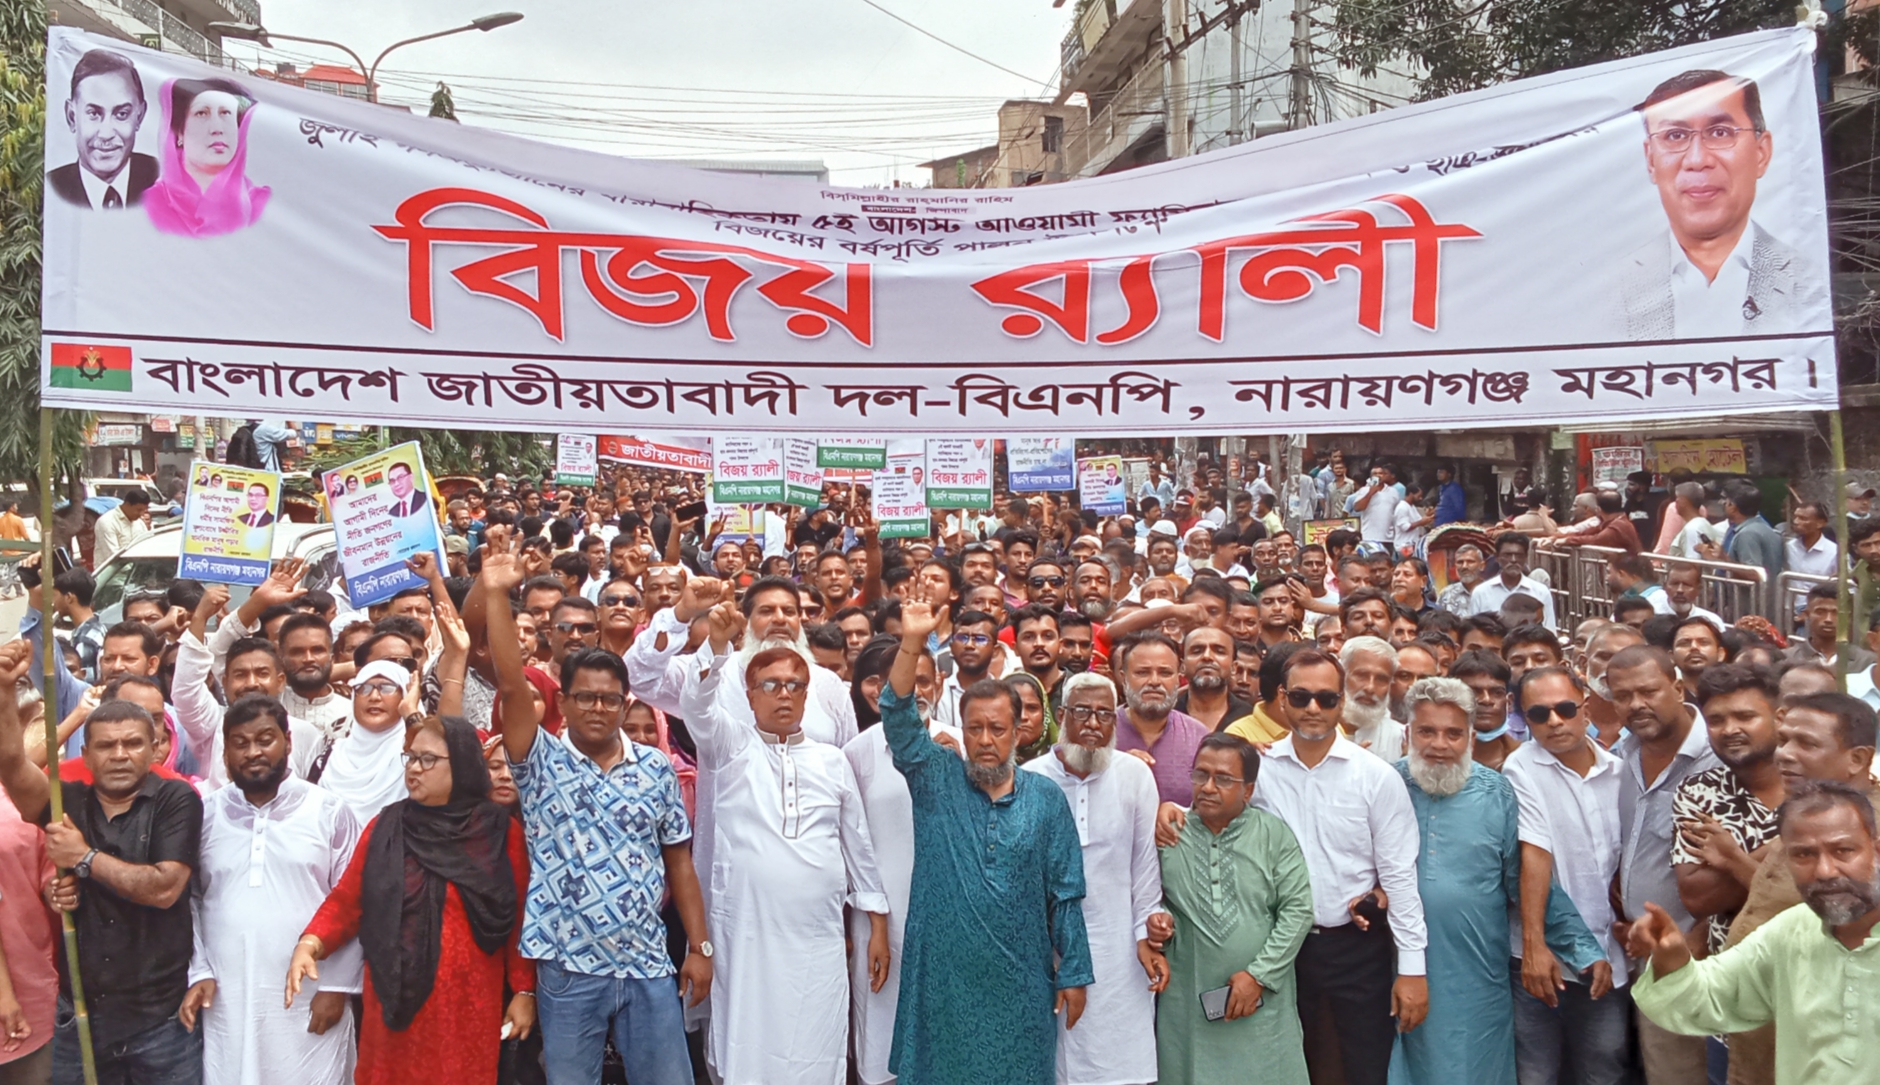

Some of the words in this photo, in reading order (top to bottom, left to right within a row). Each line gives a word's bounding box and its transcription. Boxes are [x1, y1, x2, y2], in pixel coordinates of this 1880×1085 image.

[812, 213, 859, 234] ৫ই
[867, 216, 965, 235] আগস্ট
[975, 210, 1101, 234] আওয়ামী
[714, 219, 827, 250] বিজয়ের
[836, 238, 945, 263] বর্ষপূর্তি
[369, 187, 874, 346] বিজয়
[970, 192, 1484, 345] র‍্যালী
[140, 357, 408, 402] বাংলাদেশ
[419, 363, 809, 417] জাতীয়তাবাদী
[1227, 367, 1530, 412] নারায়ণগঞ্জ
[620, 443, 712, 468] জাতীয়তাবাদী
[718, 460, 749, 477] বিজয়
[931, 468, 958, 485] বিজয়
[348, 493, 378, 509] আমাদের
[877, 503, 900, 517] বিজয়
[343, 510, 368, 526] আগামী
[368, 504, 389, 519] দিনের
[346, 528, 363, 541] নীতি
[363, 518, 393, 535] জনগণের
[342, 540, 373, 558] জীবনমান
[374, 531, 403, 547] উন্নয়নের
[185, 557, 209, 573] বিএনপি
[361, 549, 390, 568] রাজনীতি
[354, 575, 380, 599] বিএনপি
